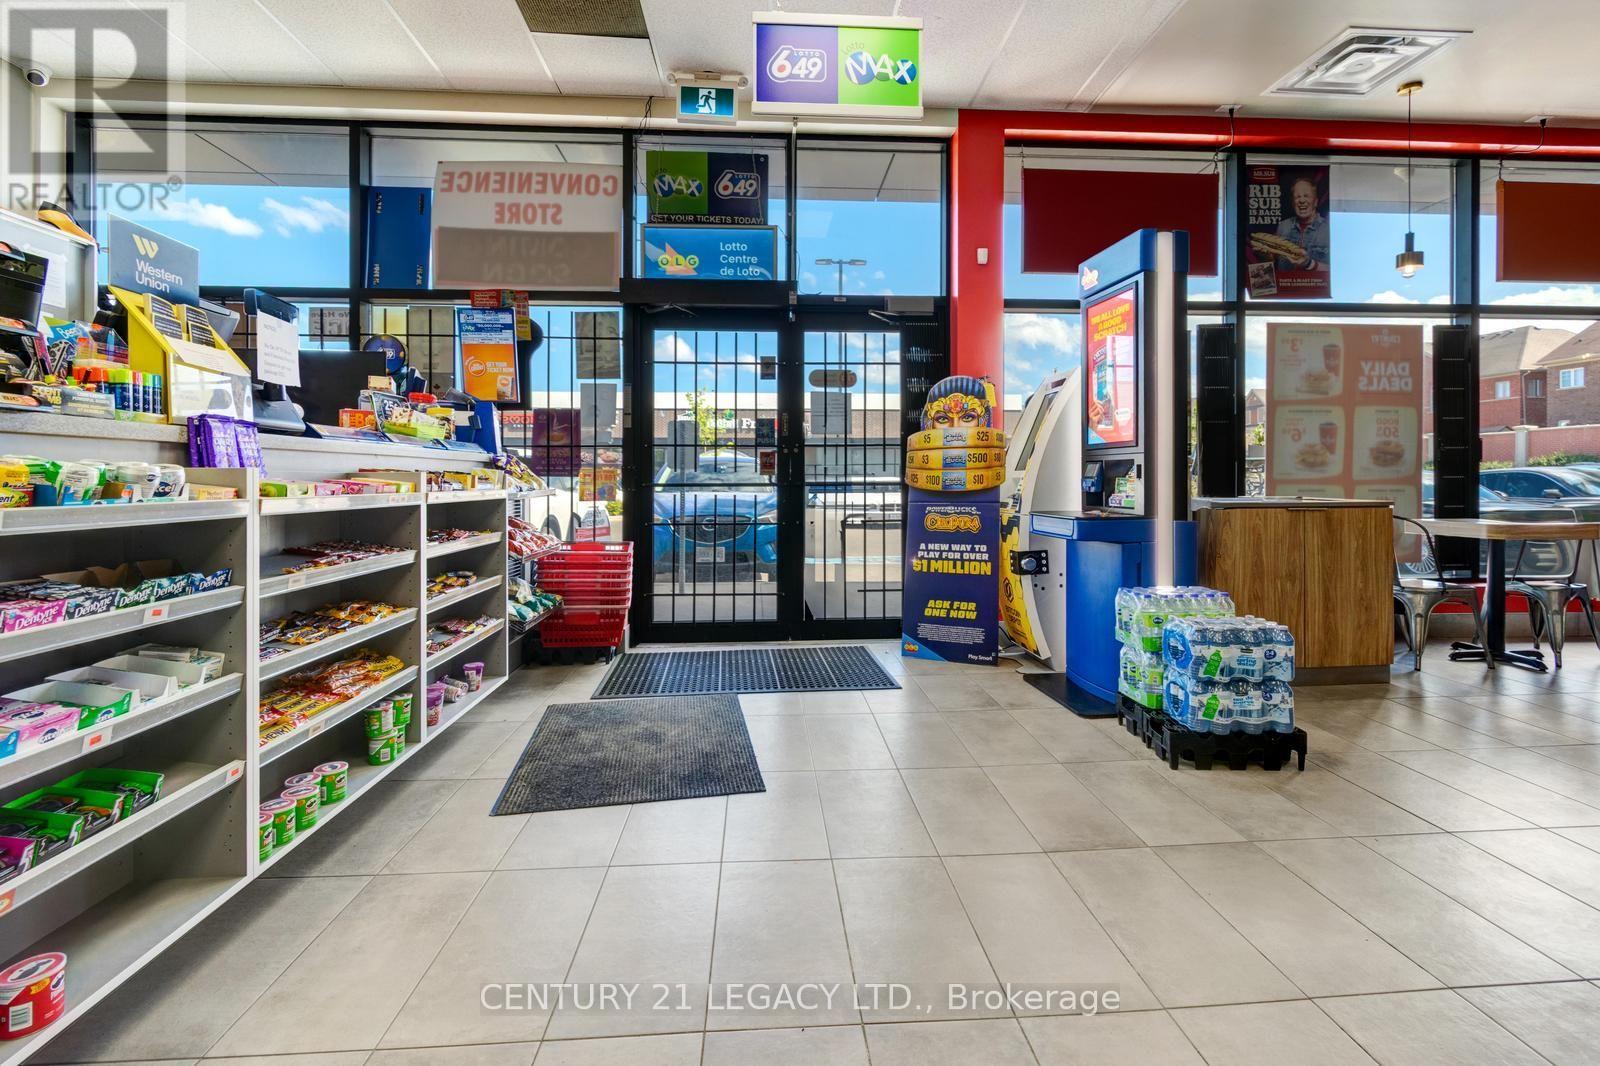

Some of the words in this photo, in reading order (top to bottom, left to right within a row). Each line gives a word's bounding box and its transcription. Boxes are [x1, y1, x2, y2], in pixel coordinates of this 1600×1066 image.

[769, 49, 823, 75] 649
[846, 51, 917, 84] MAX
[653, 174, 704, 197] MAX
[715, 171, 757, 196] 649
[1248, 184, 1281, 198] RIB
[1248, 198, 1281, 210] SUB
[651, 214, 668, 222] GET
[670, 214, 694, 222] YOUR
[696, 215, 732, 224] TICKETS
[734, 216, 764, 224] TODAY!
[1249, 216, 1282, 224] BABY!
[720, 242, 748, 250] Lotto
[659, 255, 698, 267] OLG
[720, 254, 758, 264] Centre
[136, 259, 183, 286] Western
[720, 266, 734, 276] de
[737, 266, 760, 276] Loto
[135, 271, 170, 293] Union
[924, 434, 930, 444] $5
[976, 432, 990, 442] $25
[922, 454, 928, 464] $3
[968, 453, 988, 463] $500
[926, 475, 940, 486] $100
[973, 474, 984, 484] $10
[912, 560, 928, 572] $1
[930, 560, 992, 575] MILLION
[154, 580, 186, 598] Dentyne
[200, 574, 226, 590] Dentyne
[120, 588, 150, 606] Dentyne
[75, 597, 112, 618] Dentyne
[928, 600, 950, 608] ASK
[954, 602, 976, 610] FOR
[15, 606, 60, 630] Dentyne
[924, 608, 947, 617] ONE
[950, 610, 976, 620] NOW
